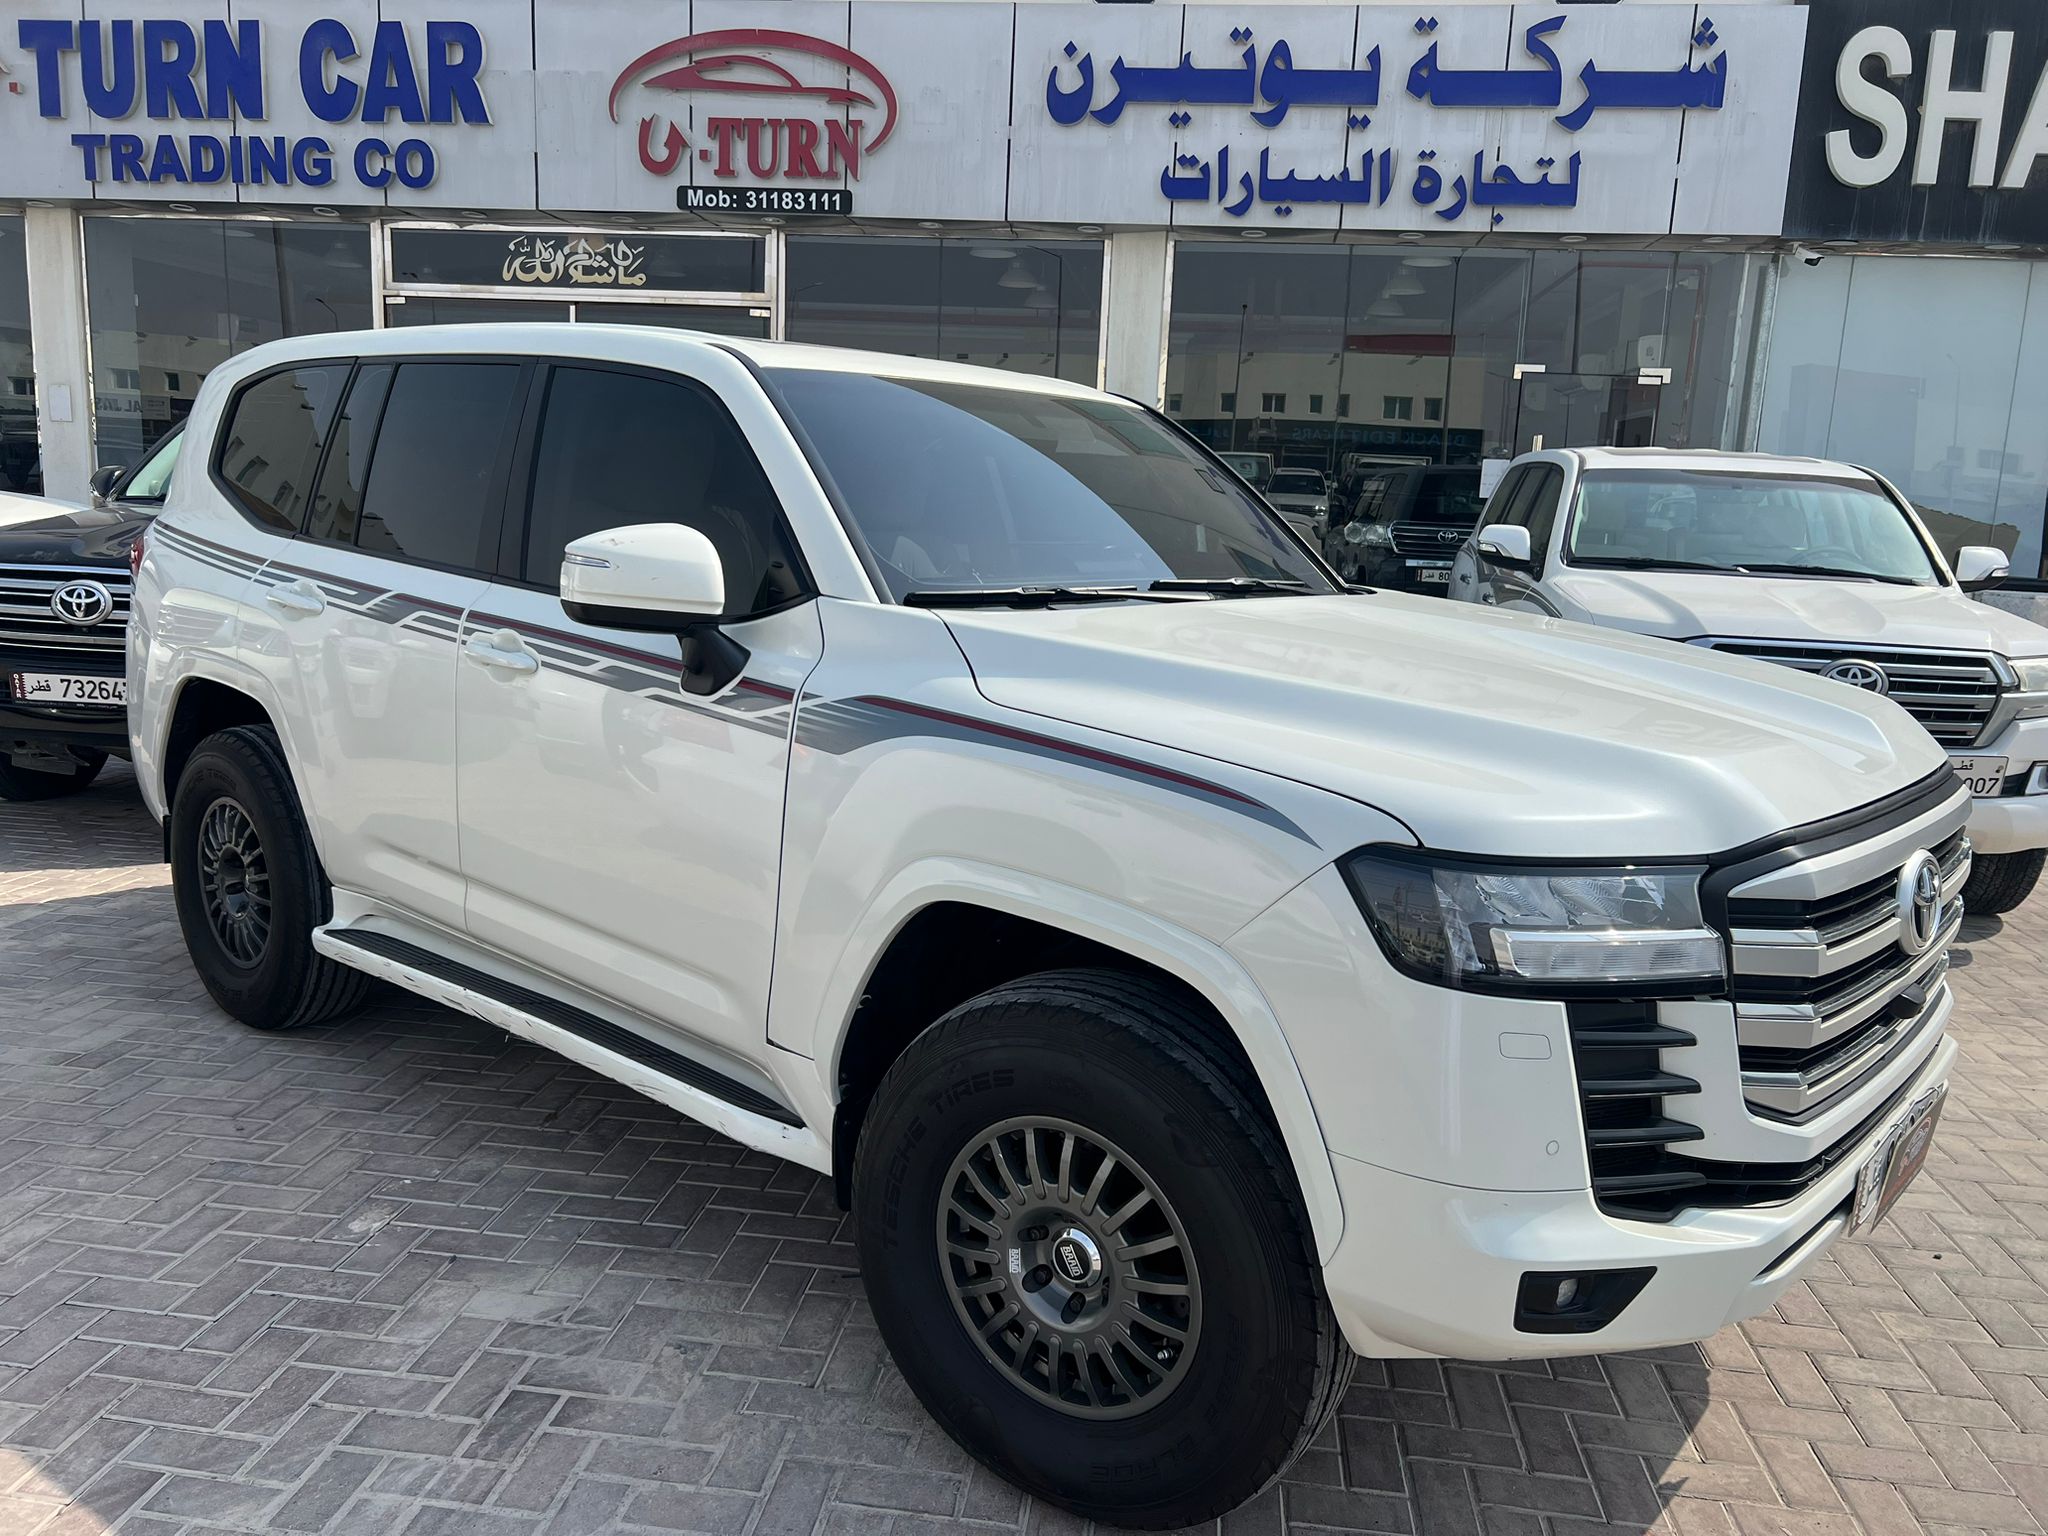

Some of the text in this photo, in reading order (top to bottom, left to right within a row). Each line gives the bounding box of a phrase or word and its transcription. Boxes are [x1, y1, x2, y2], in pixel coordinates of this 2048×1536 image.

[18, 18, 494, 125] TURN CAR
[1046, 15, 1728, 133] شركة يوتيرن
[71, 134, 437, 189] TRADING CO
[1160, 144, 1581, 224] لتجارة السيارات
[687, 189, 842, 211] Mob: 31183111
[1062, 1245, 1082, 1277] BRAID
